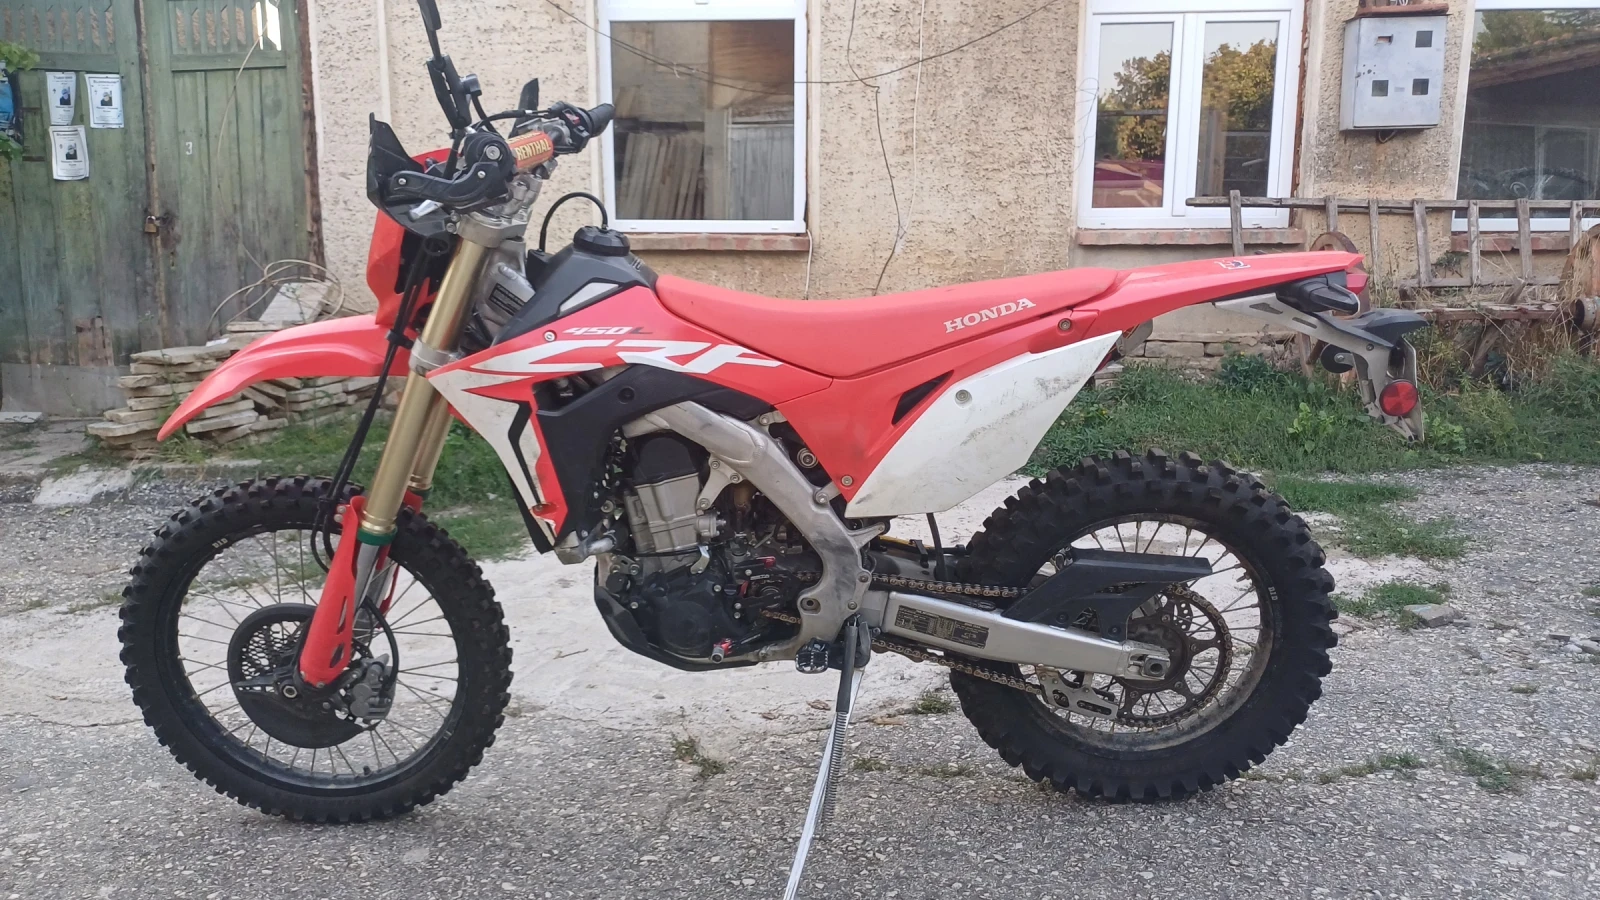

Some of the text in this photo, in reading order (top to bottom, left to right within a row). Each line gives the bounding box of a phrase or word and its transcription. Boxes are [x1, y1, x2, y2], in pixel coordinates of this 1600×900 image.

[514, 138, 552, 160] RENTHAL
[943, 298, 1036, 333] HONDA
[563, 326, 652, 336] 450L
[470, 339, 784, 374] CRF
